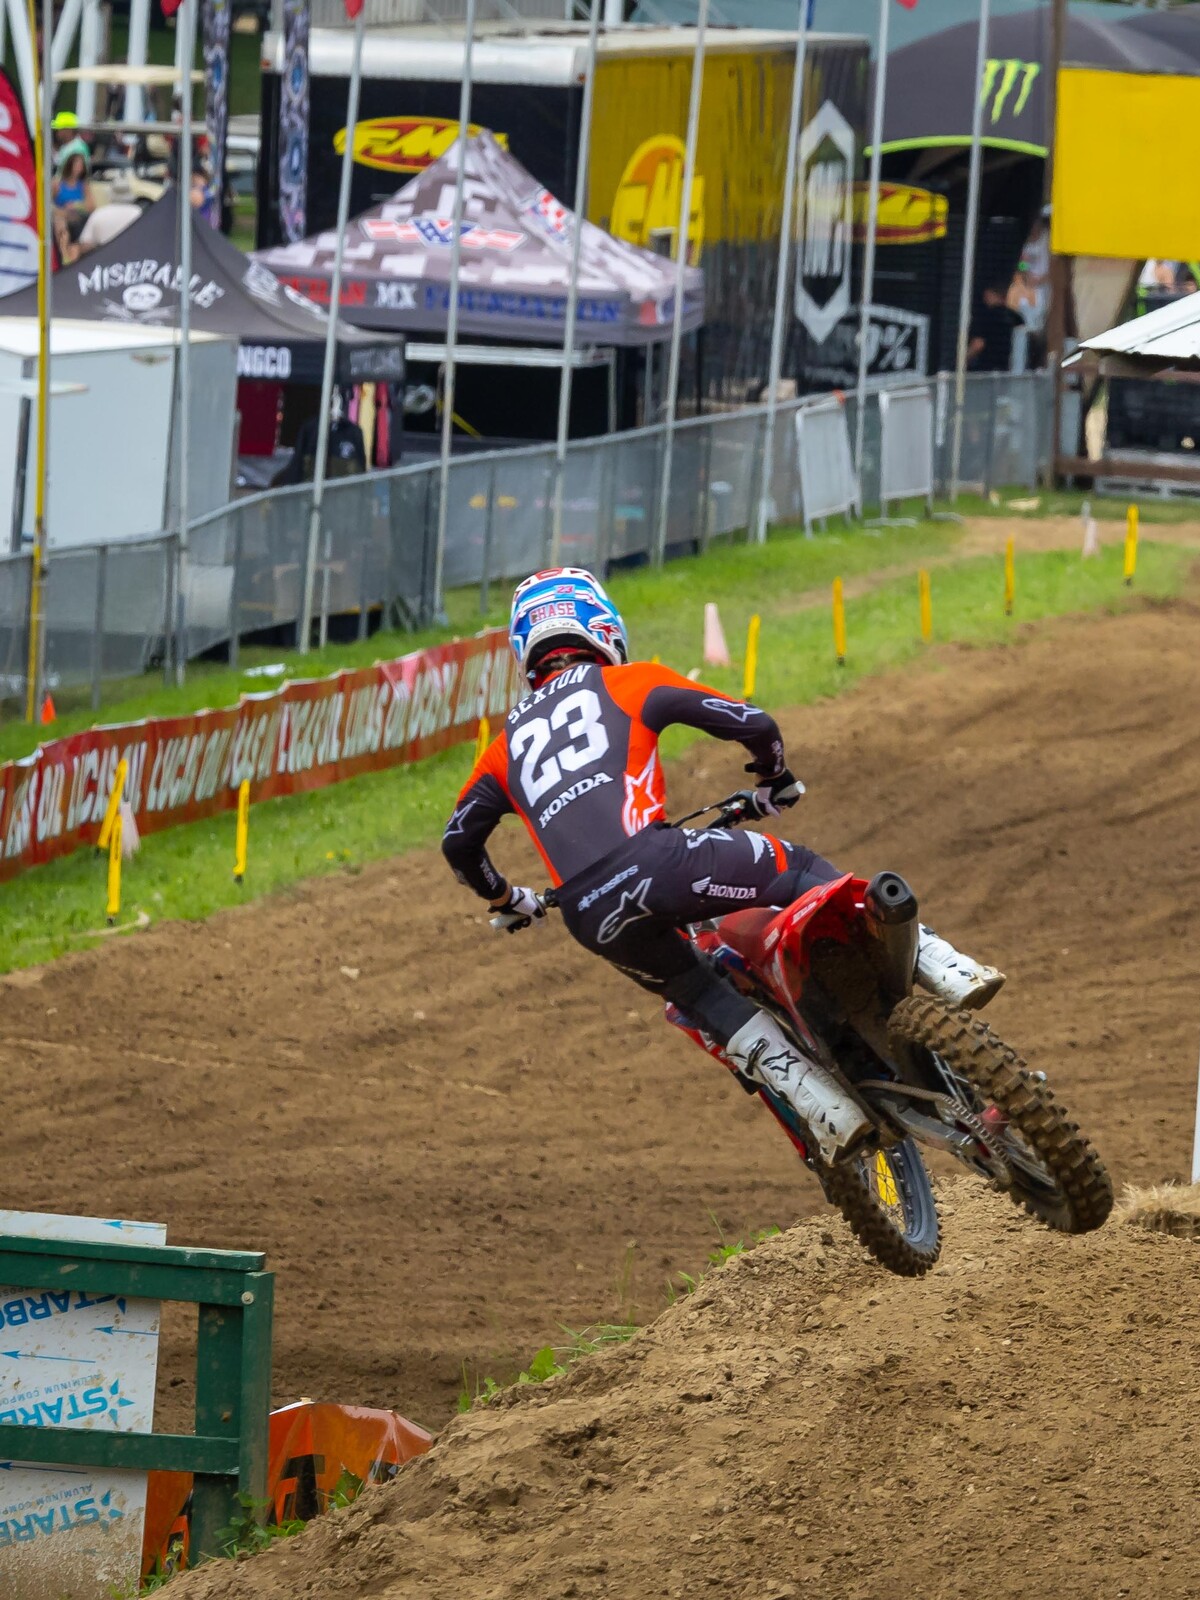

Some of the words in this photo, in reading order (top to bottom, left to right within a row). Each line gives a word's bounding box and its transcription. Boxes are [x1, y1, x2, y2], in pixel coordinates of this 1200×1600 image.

[374, 280, 417, 310] MX
[556, 585, 574, 594] 23
[507, 664, 592, 724] SEXTON
[509, 688, 610, 808] 23
[538, 772, 614, 829] HONDA
[706, 882, 757, 900] HONDA
[36, 1484, 93, 1507] ALUMINUM
